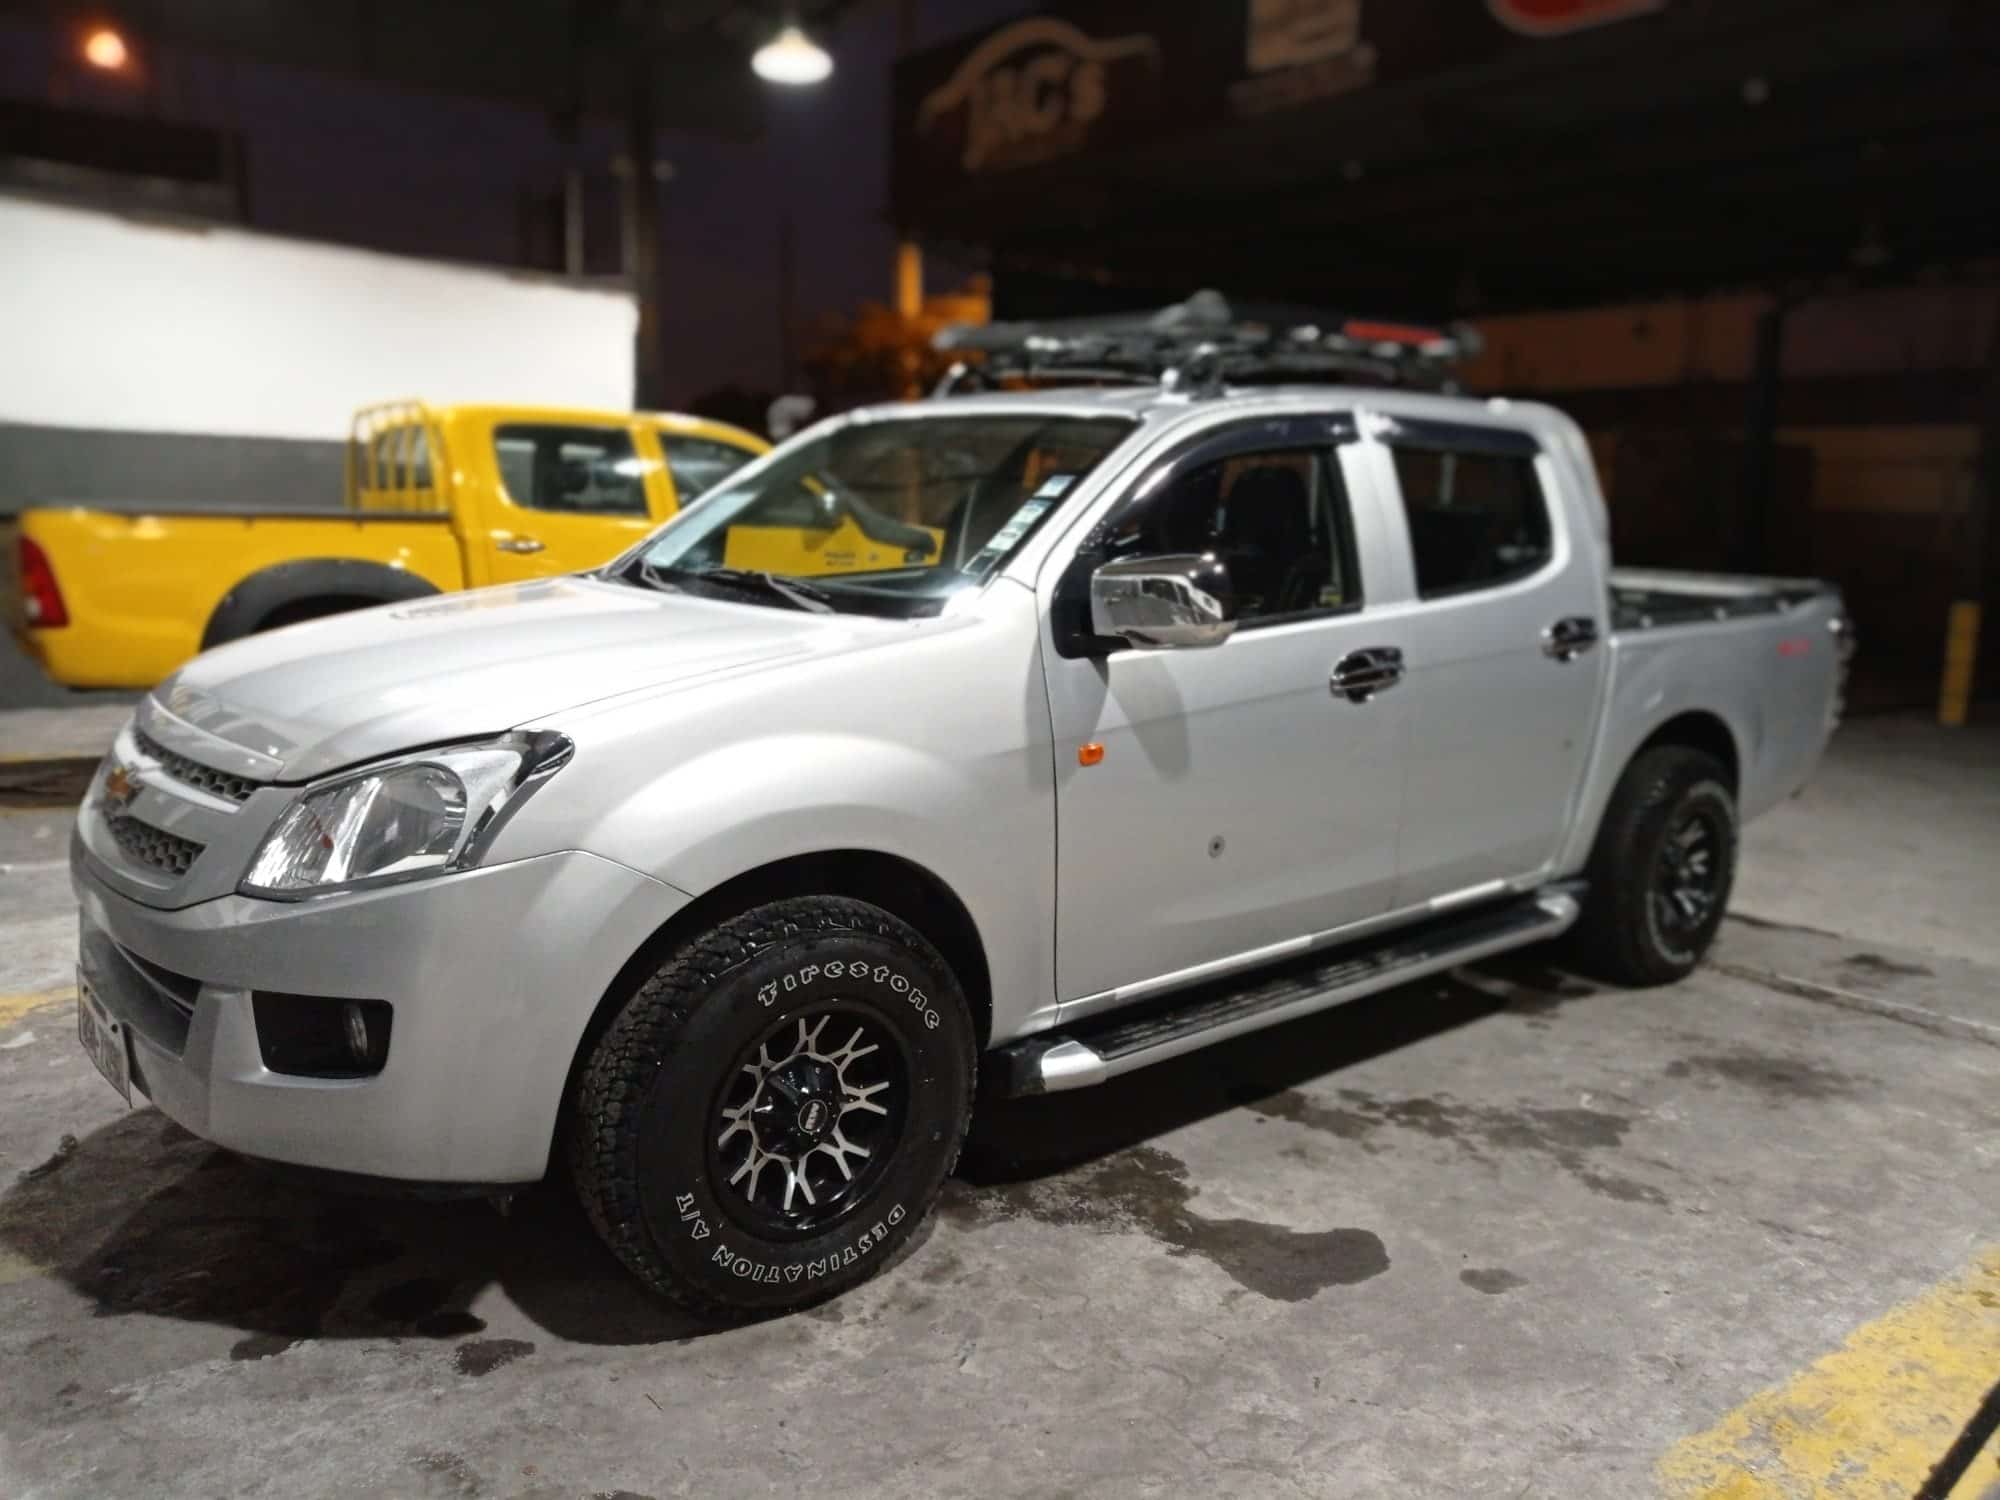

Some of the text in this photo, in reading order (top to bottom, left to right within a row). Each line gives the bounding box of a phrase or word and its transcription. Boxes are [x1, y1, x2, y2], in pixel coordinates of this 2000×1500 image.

[758, 961, 940, 1030] Firestone
[676, 1192, 905, 1283] DESTINATION A/T
